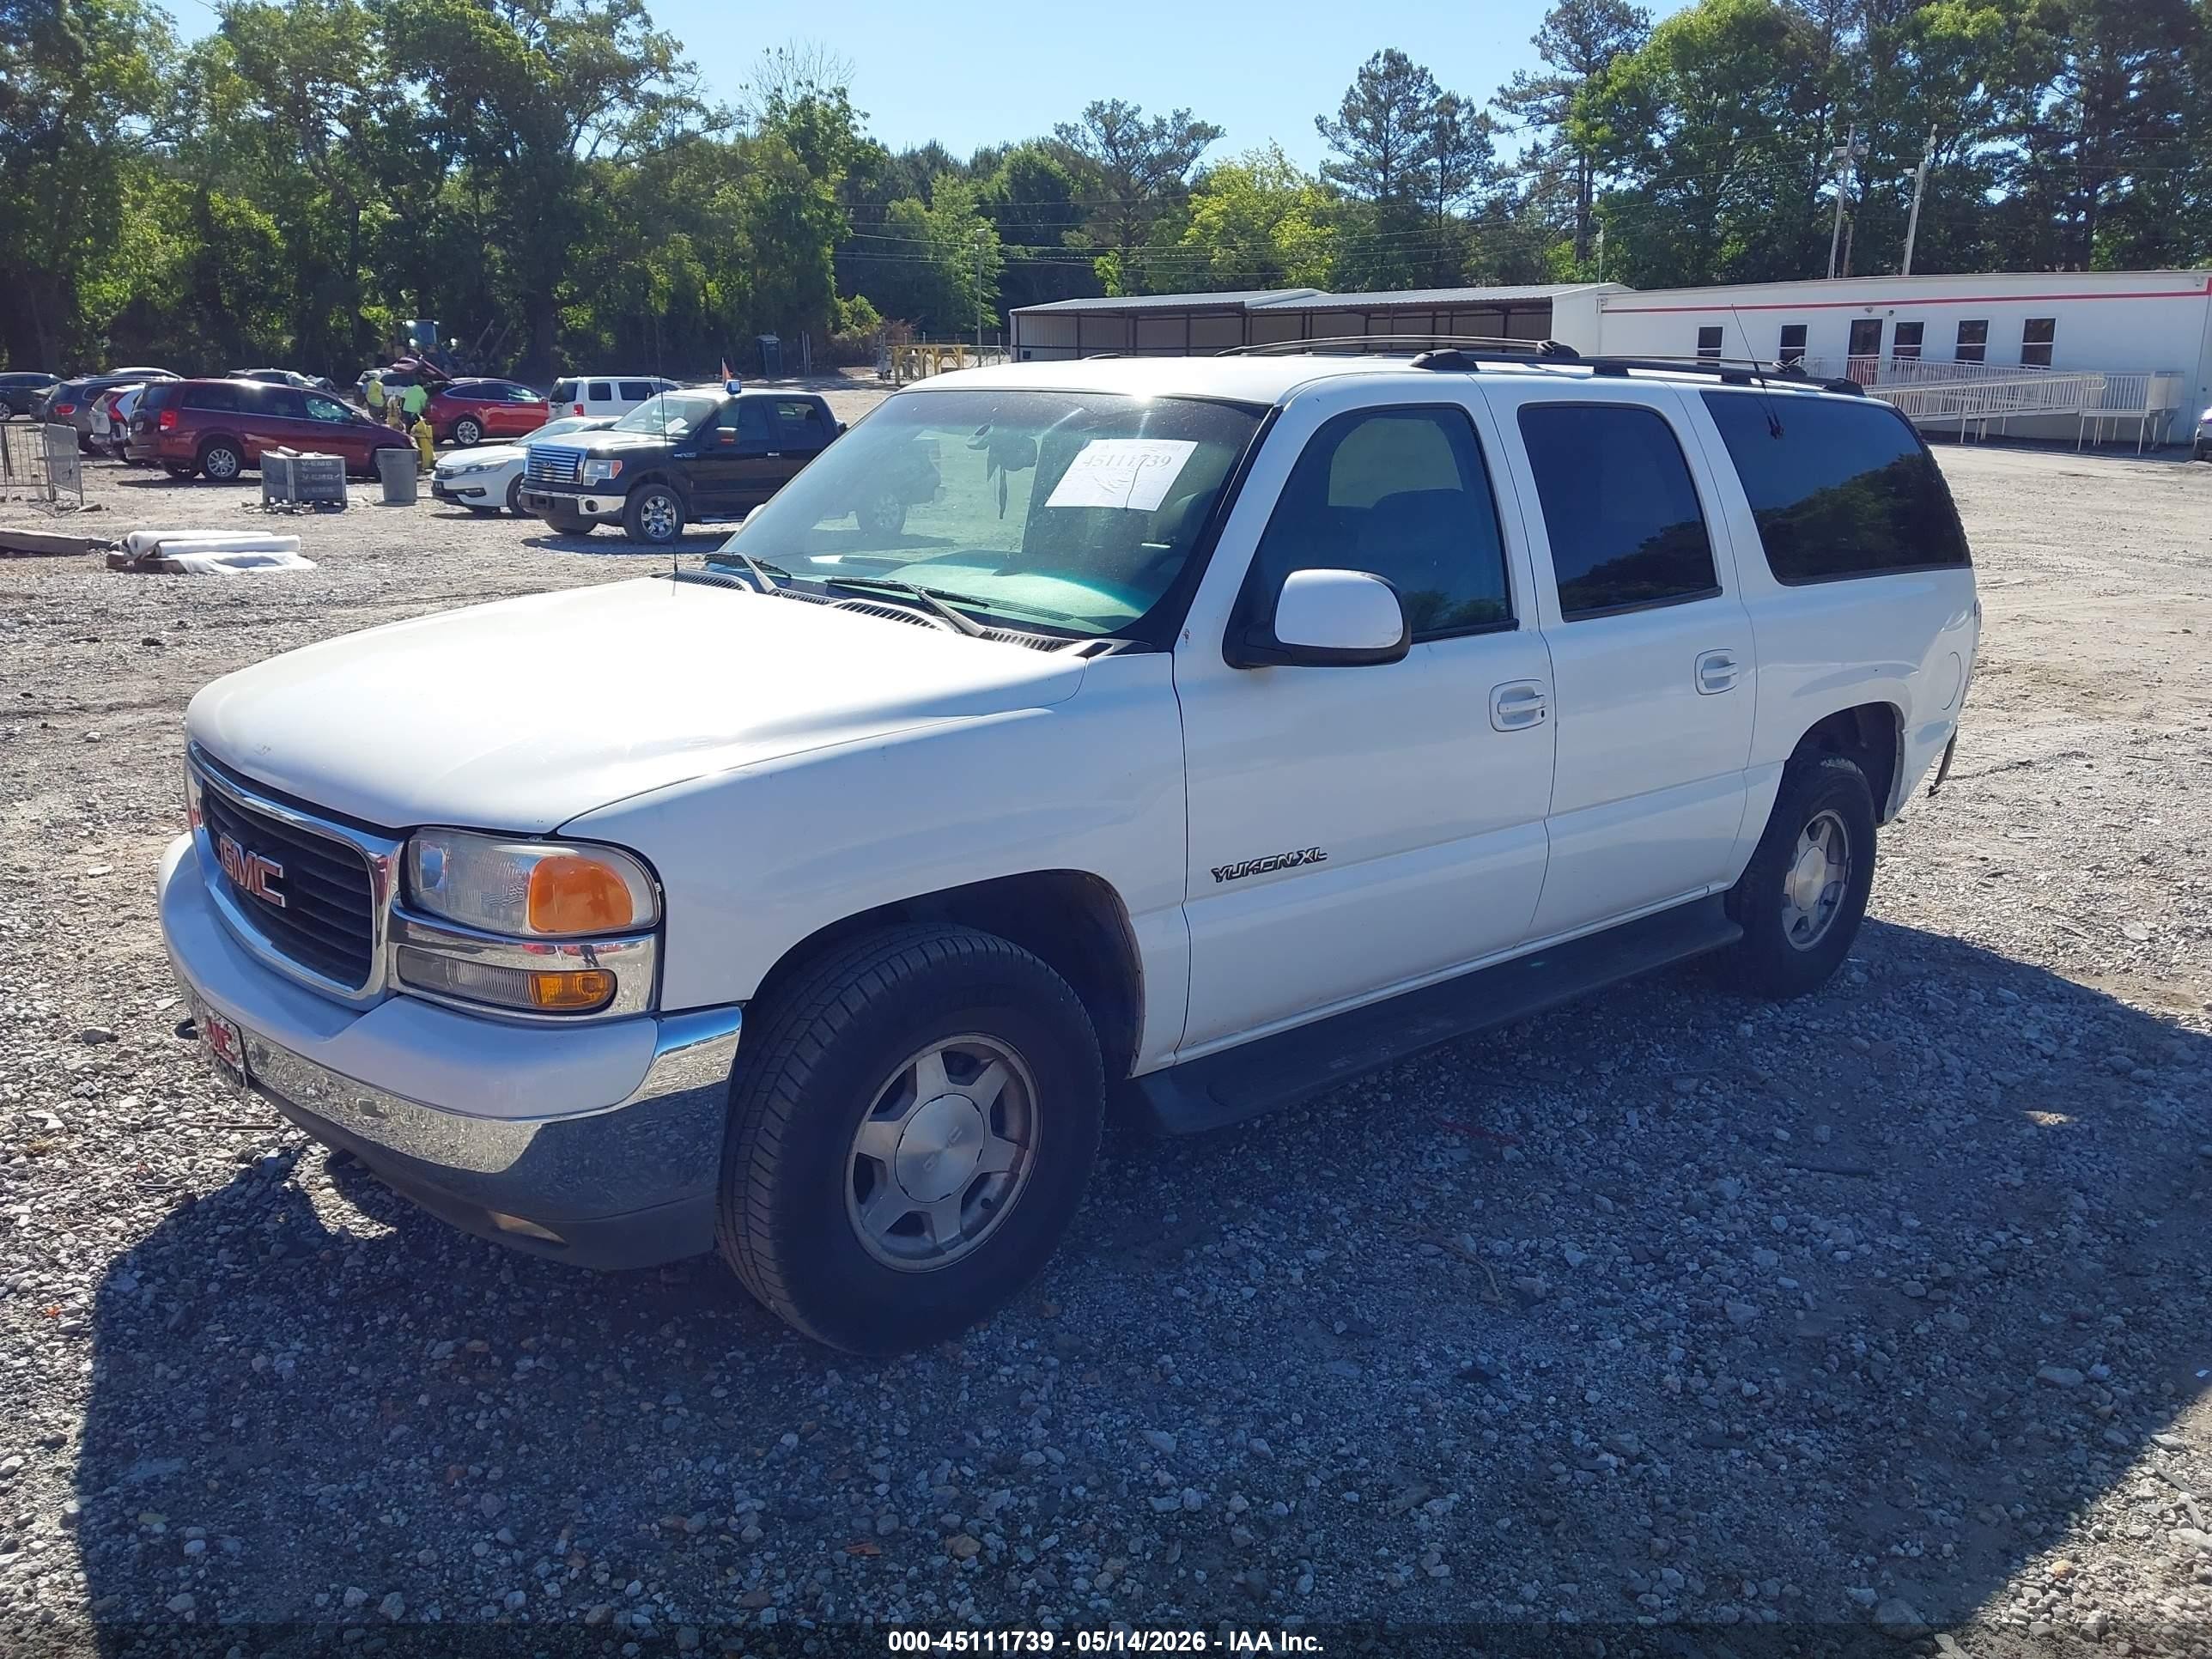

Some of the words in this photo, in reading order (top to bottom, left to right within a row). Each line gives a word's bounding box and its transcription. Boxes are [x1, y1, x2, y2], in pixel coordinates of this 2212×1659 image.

[219, 832, 286, 908] GMC
[1211, 852, 1294, 883] YUKON
[1296, 847, 1328, 866] XL
